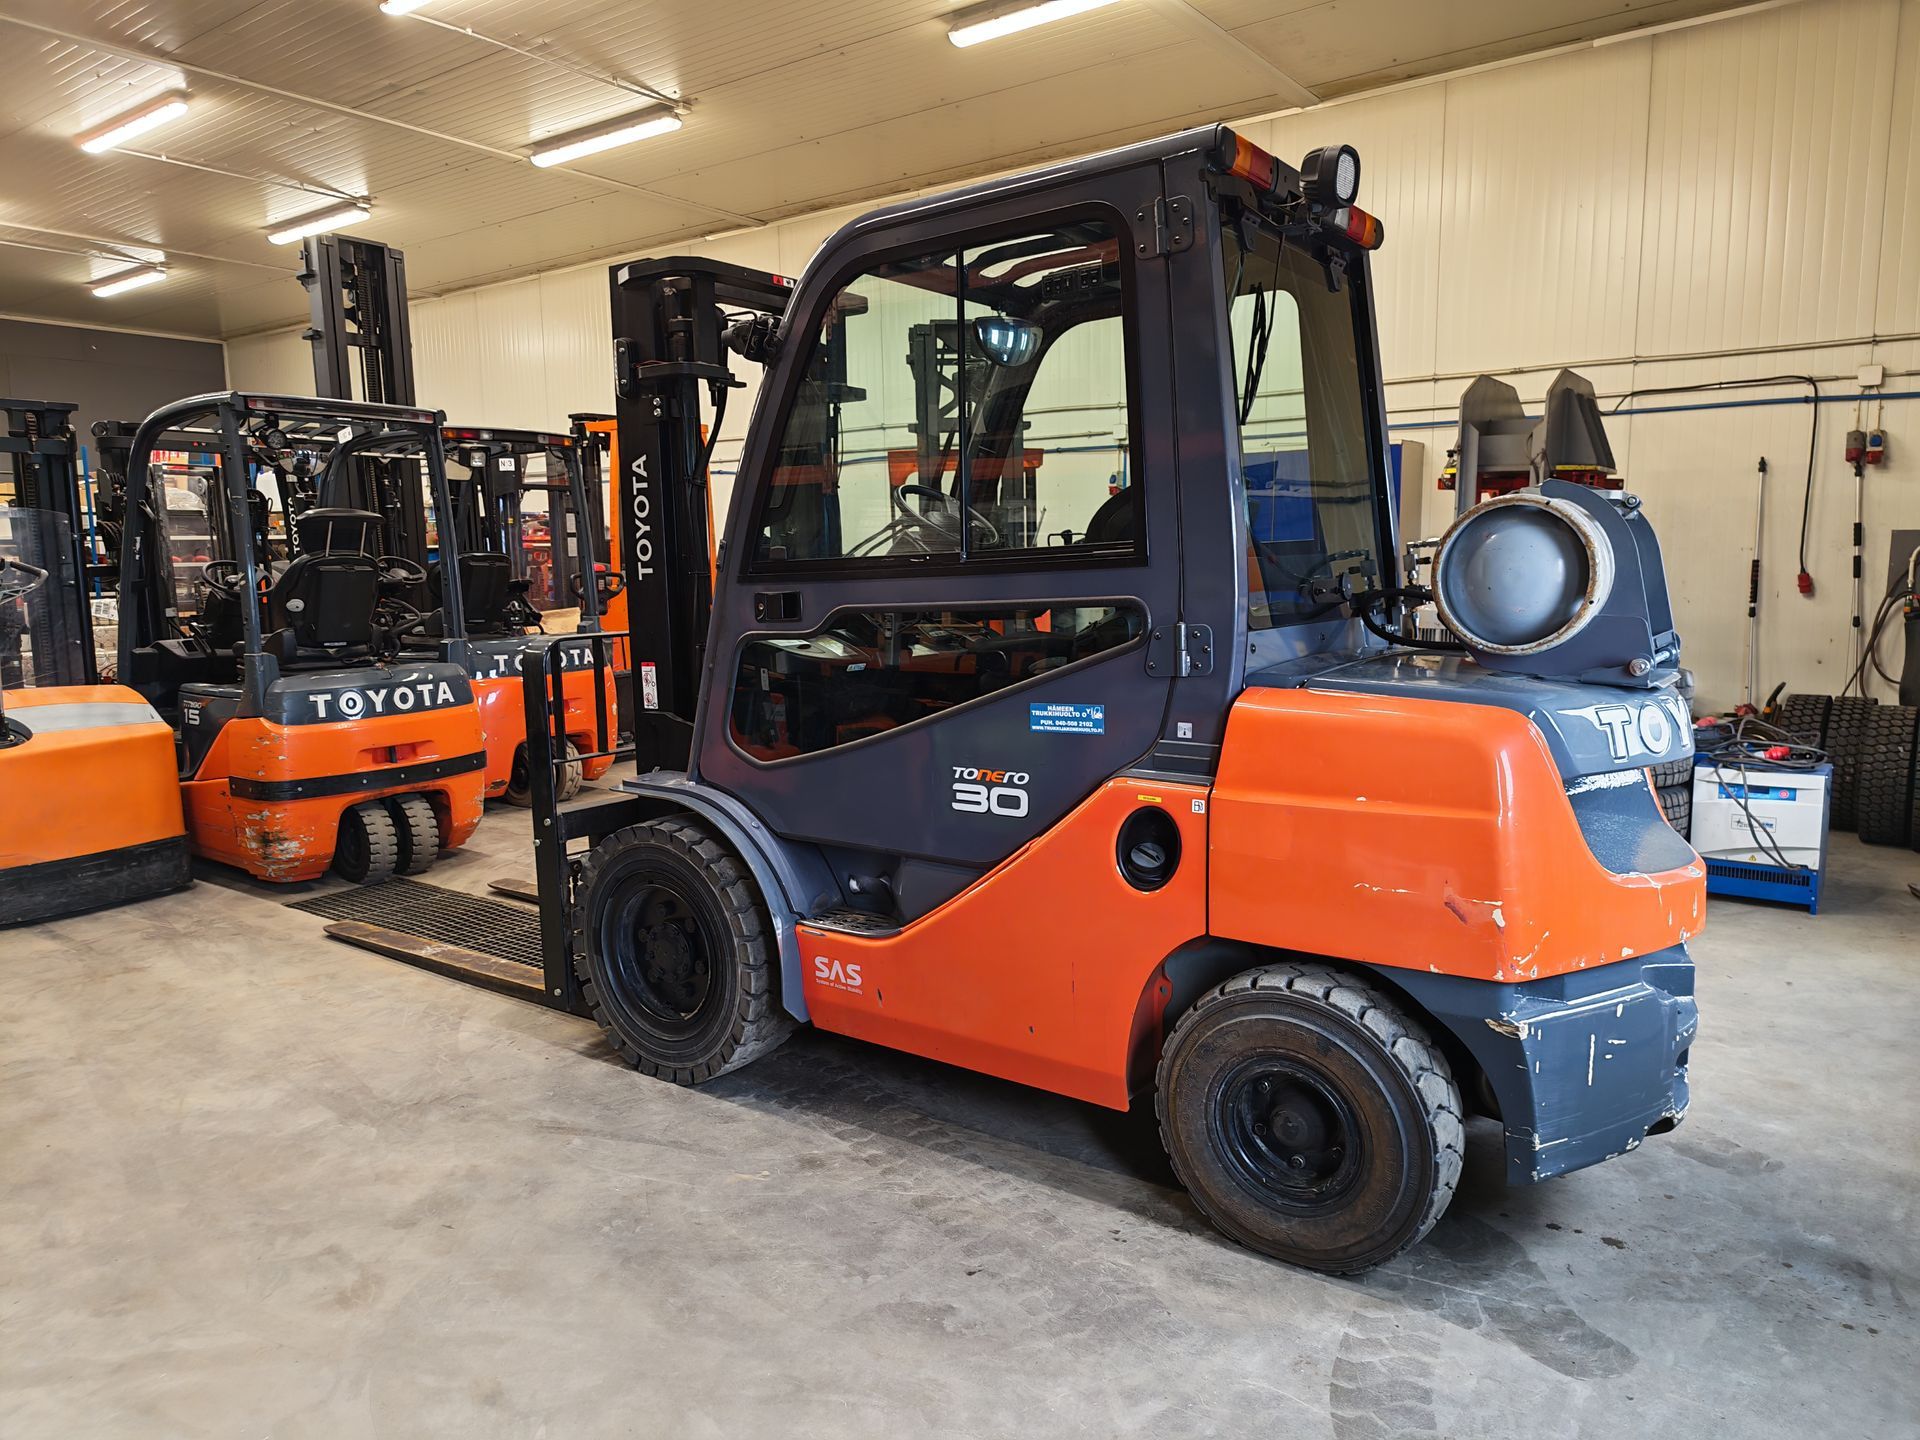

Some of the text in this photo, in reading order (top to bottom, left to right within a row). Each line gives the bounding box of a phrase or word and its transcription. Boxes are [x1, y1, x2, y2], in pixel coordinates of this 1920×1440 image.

[287, 497, 301, 555] TOYOTA
[631, 454, 654, 581] TOYOTA
[184, 708, 200, 725] 15
[308, 681, 456, 719] TOYOTA
[1031, 710, 1080, 718] TRUKKIHUOLTO
[951, 782, 1029, 818] 30
[814, 956, 862, 986] SAS
